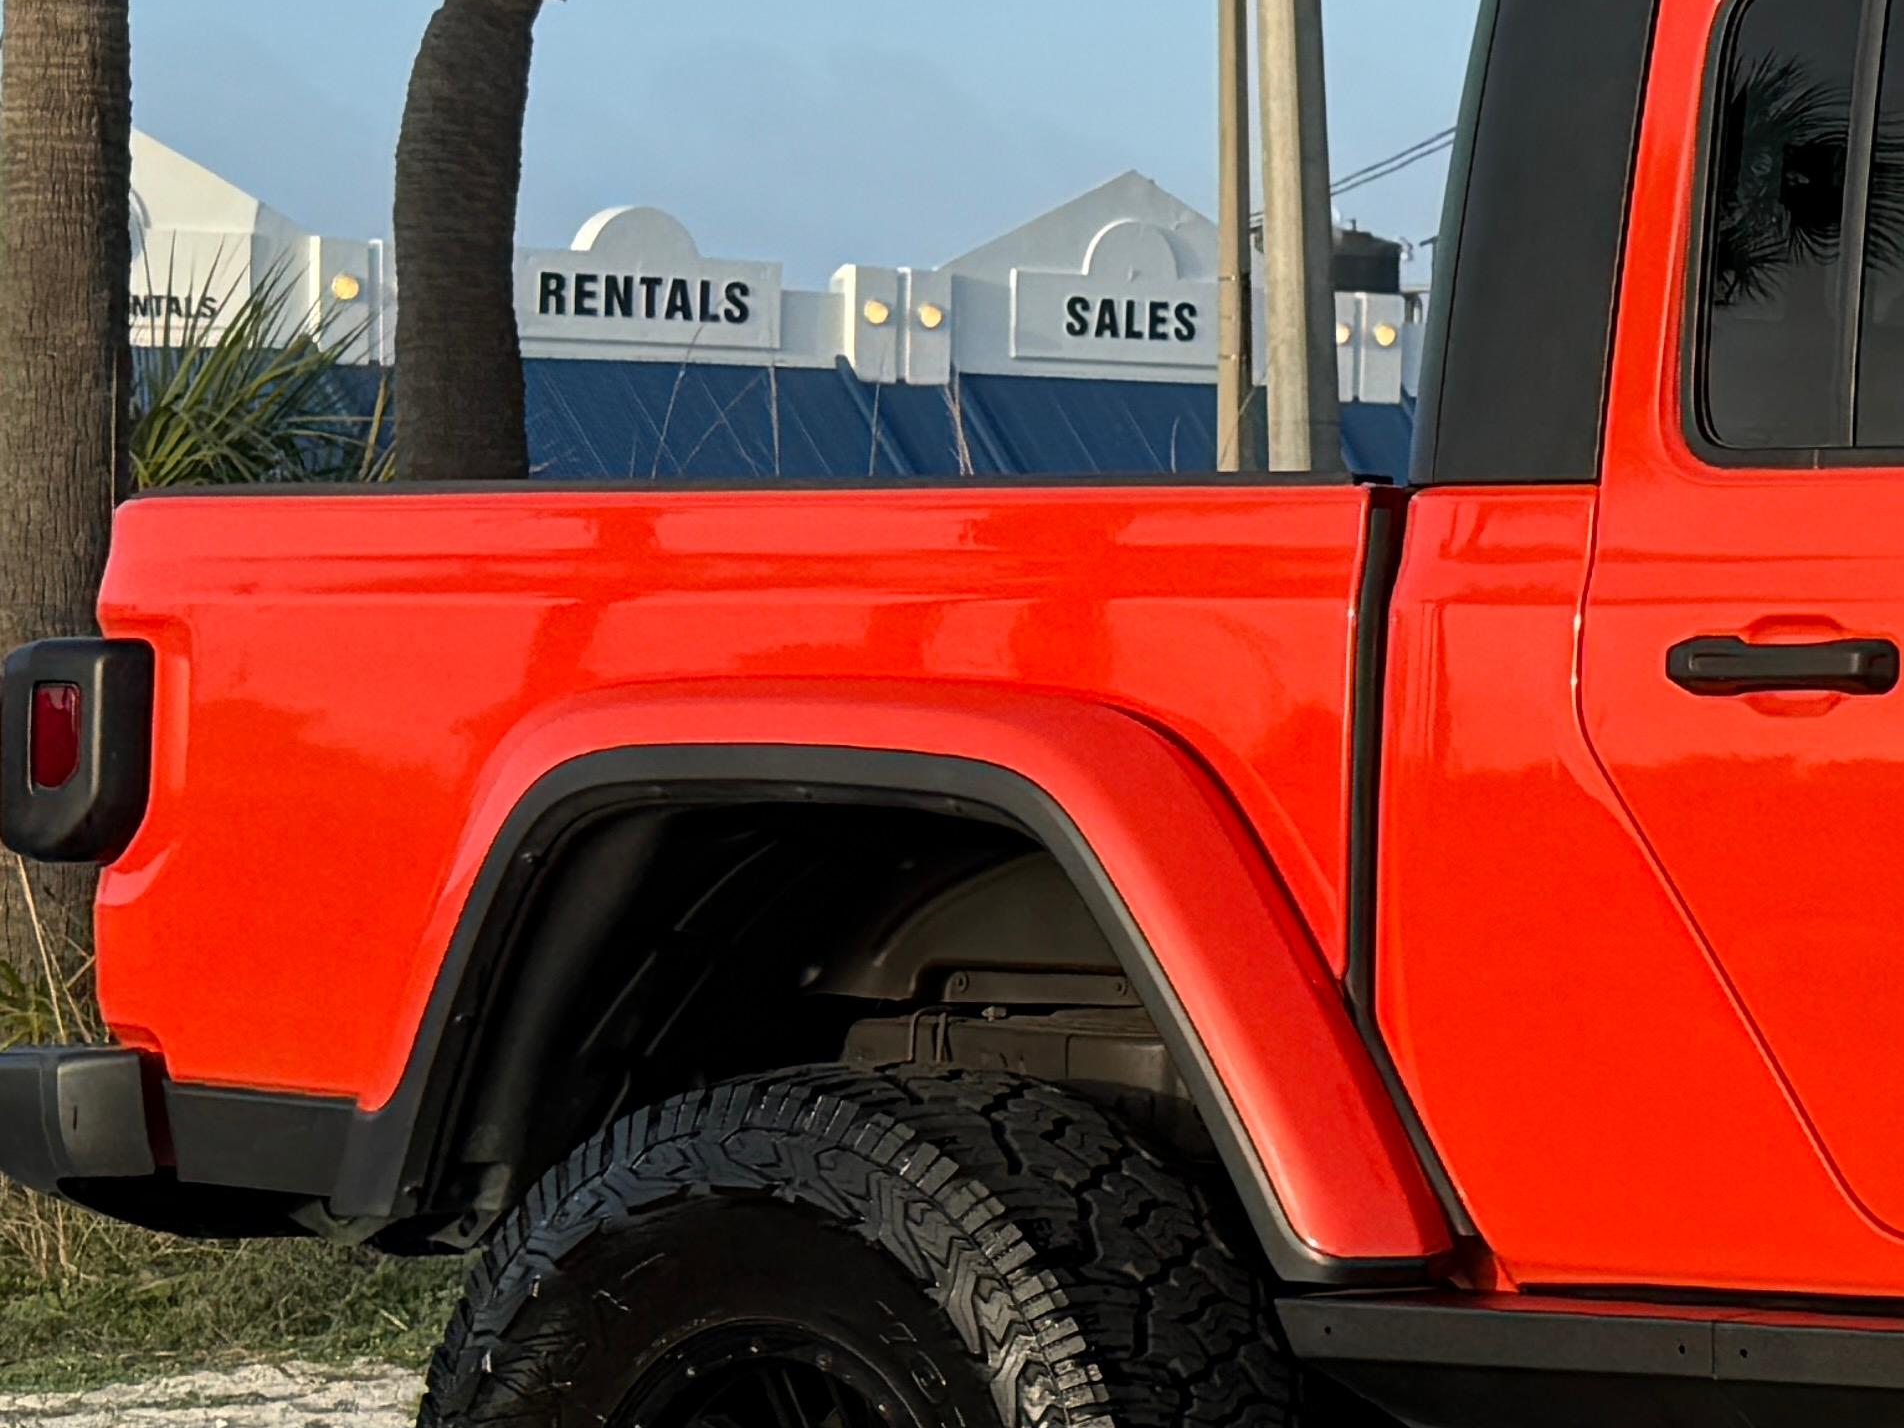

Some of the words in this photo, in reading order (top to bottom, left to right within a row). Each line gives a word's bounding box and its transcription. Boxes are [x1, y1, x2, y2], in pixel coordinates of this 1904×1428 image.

[130, 294, 218, 319] NTALS
[538, 270, 750, 324] RENTALS
[1065, 295, 1198, 342] SALES
